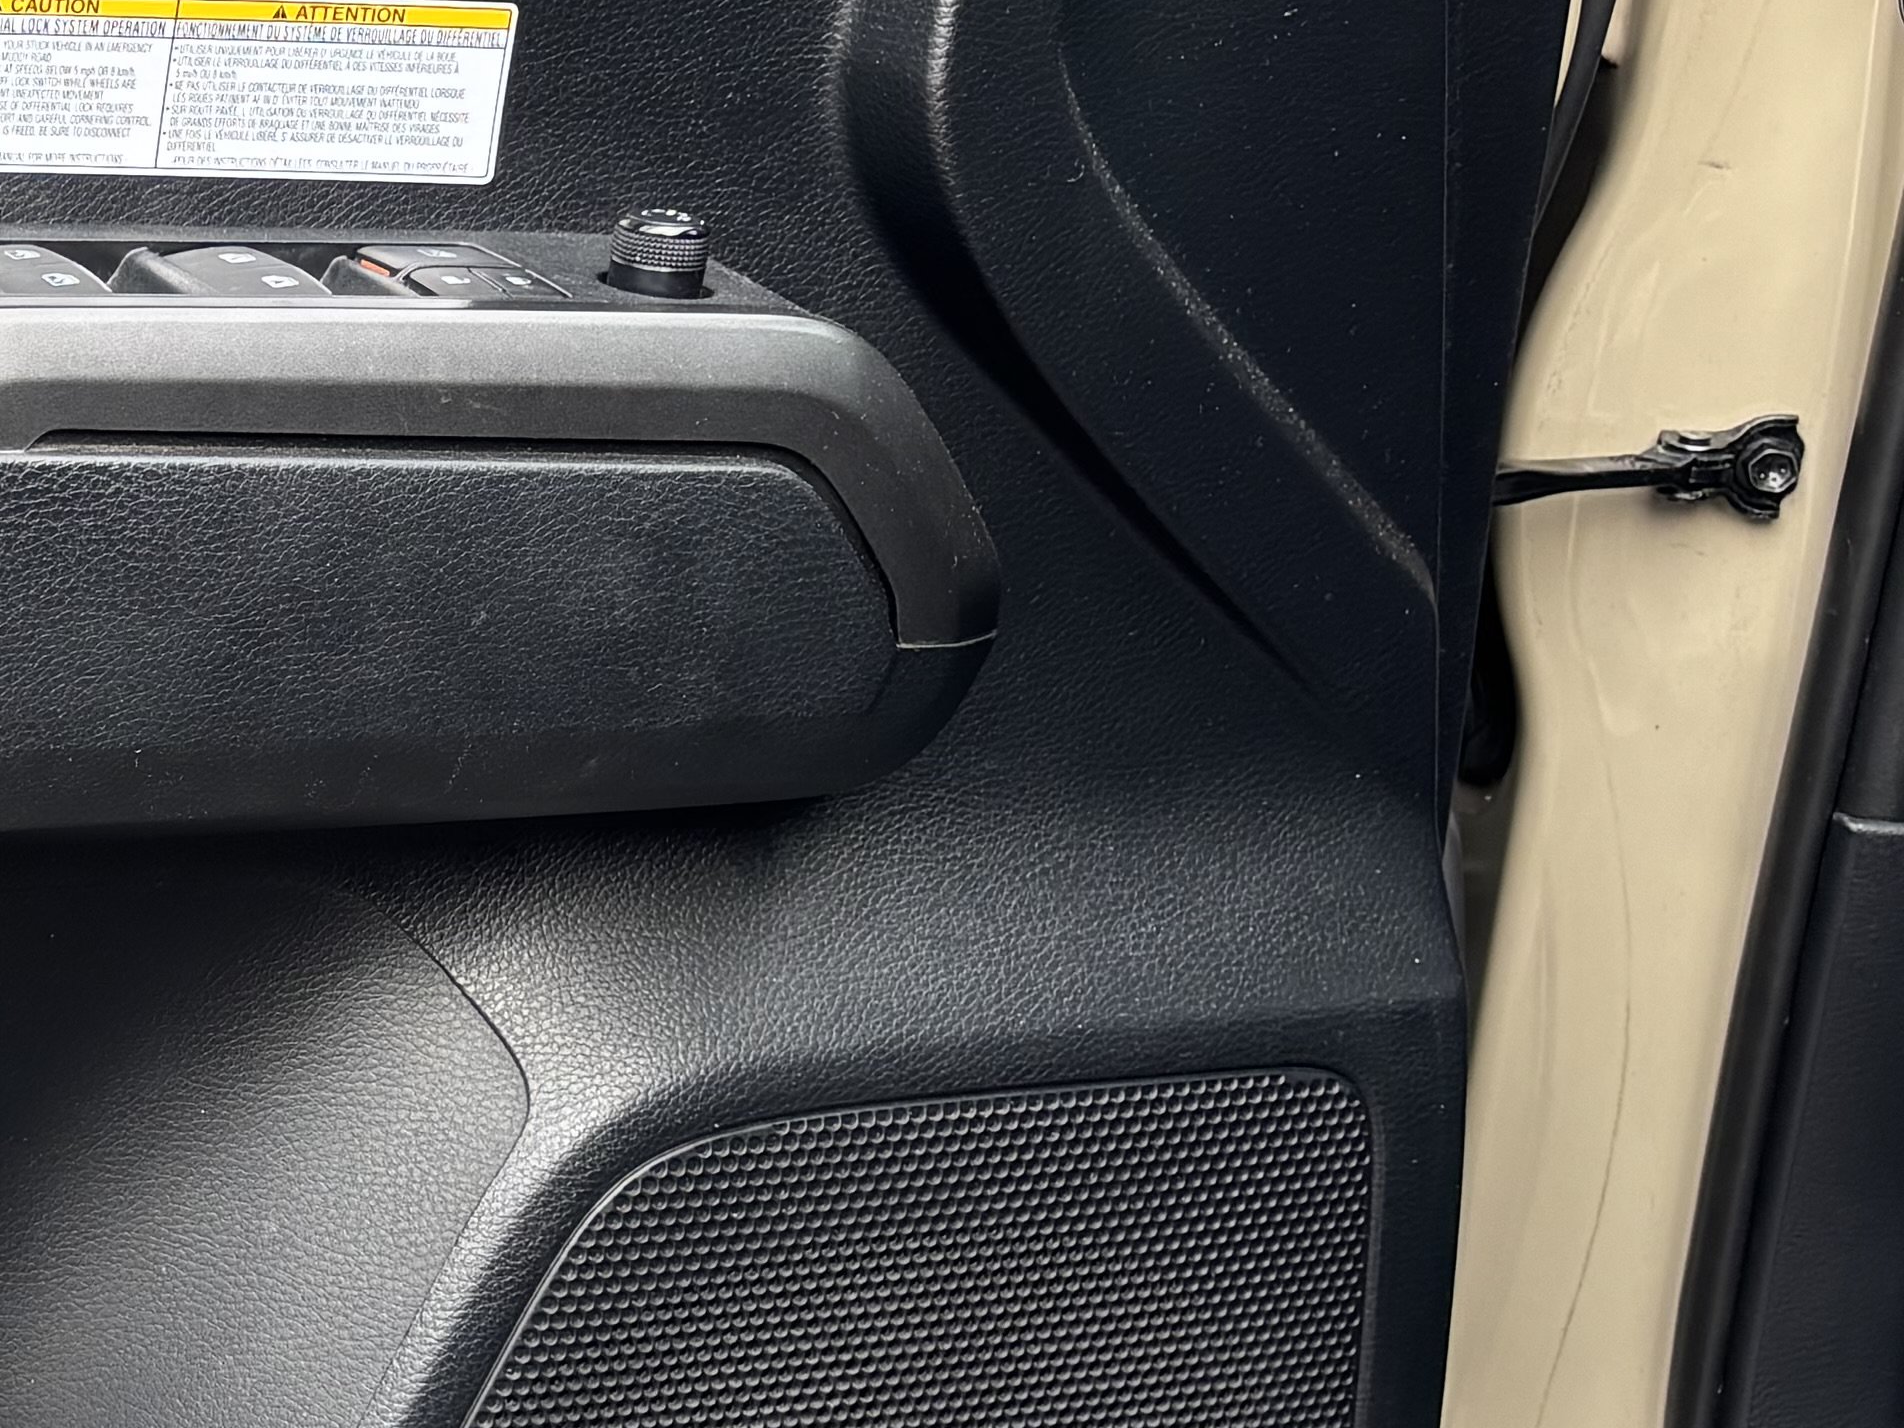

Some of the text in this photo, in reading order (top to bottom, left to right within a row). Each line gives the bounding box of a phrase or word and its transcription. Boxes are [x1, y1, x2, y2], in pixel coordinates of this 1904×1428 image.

[295, 5, 406, 23] ATTENTION
[20, 16, 50, 34] LOCK
[53, 17, 100, 35] SYSTEM
[102, 19, 166, 37] OPERATION
[176, 21, 263, 39] FONCTIONNEMENT
[266, 23, 281, 40] DU
[329, 25, 342, 42] DE
[345, 26, 417, 44] VERROUILLAGE
[419, 28, 434, 44] DU
